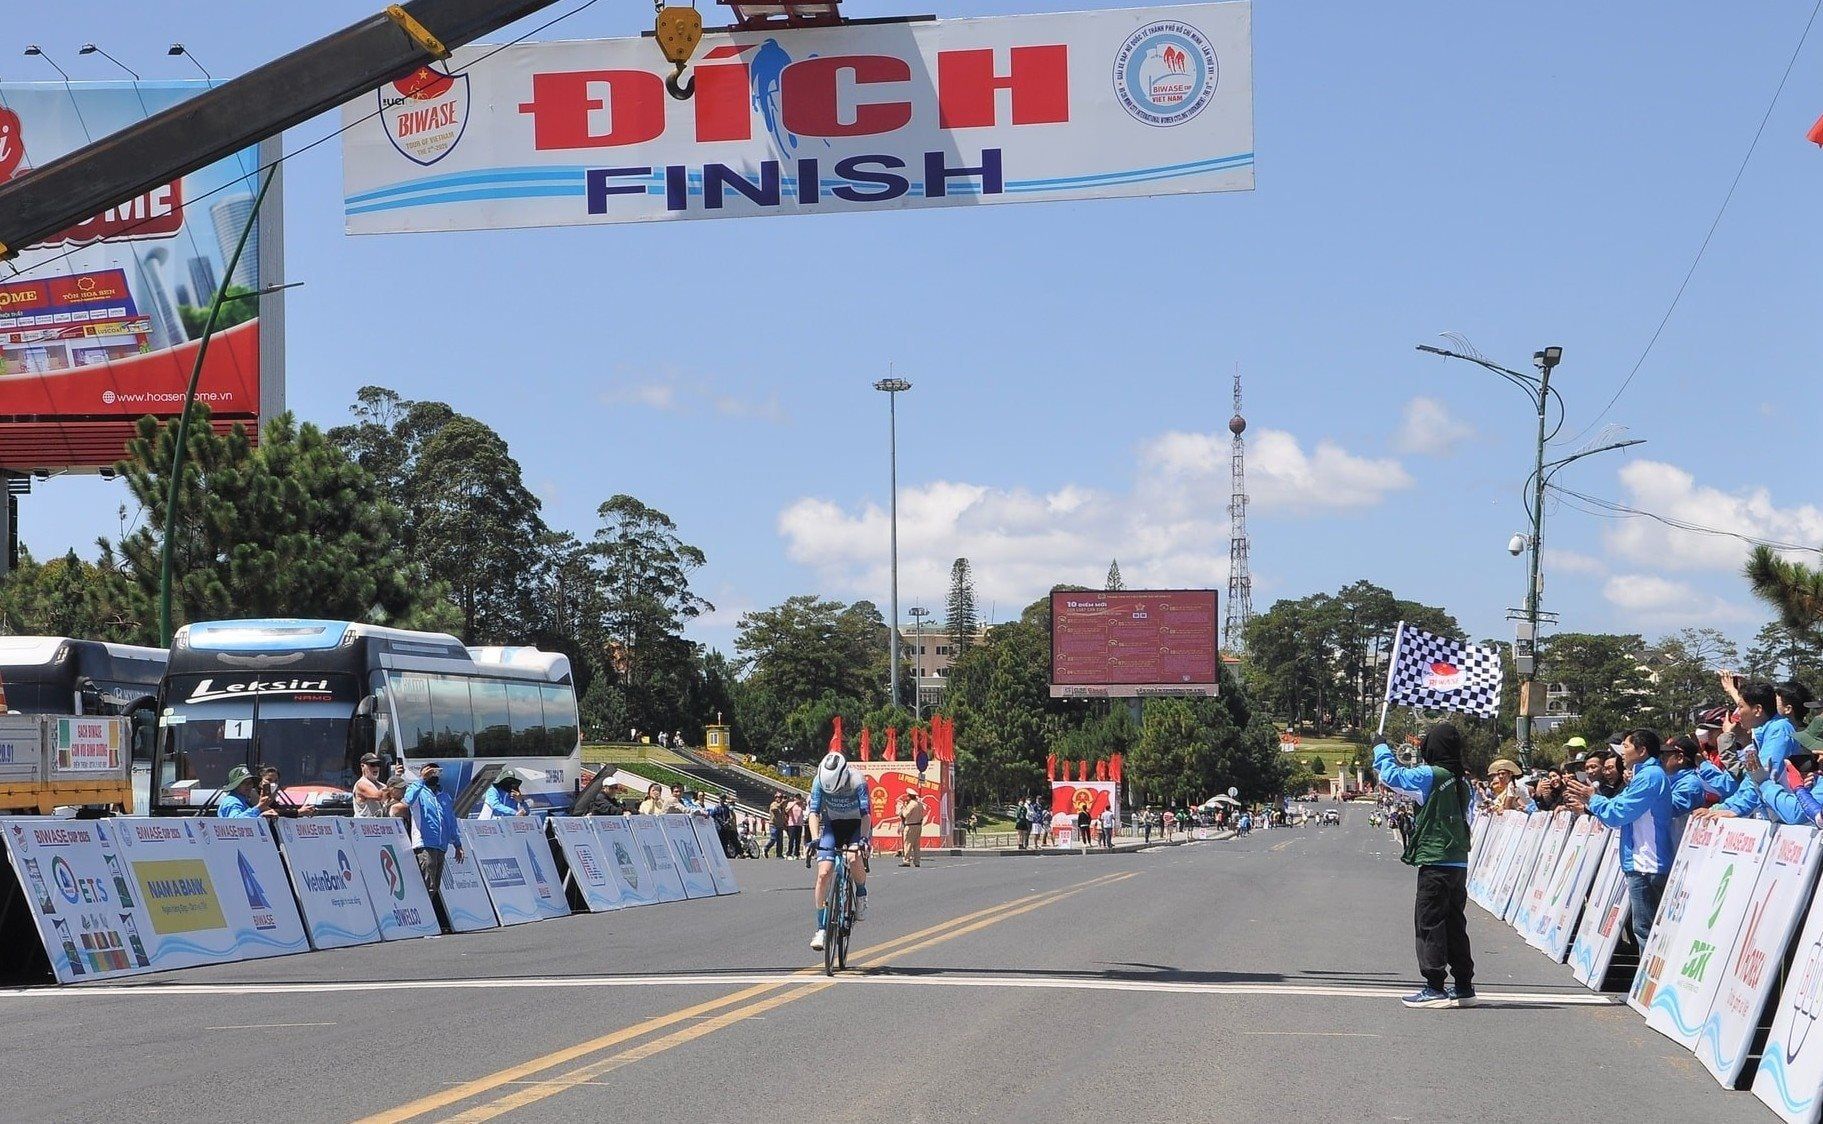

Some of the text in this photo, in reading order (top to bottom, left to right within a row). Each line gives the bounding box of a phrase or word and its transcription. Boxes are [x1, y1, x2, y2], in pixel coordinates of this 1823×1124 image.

[518, 43, 1069, 150] ĐÍCH
[1153, 84, 1183, 94] BIWASE
[397, 100, 459, 138] BIWASE
[586, 148, 1003, 215] FINISH
[116, 391, 233, 402] www.hoasenome.vn
[186, 678, 333, 704] Leksiri
[234, 721, 243, 738] 1
[34, 829, 70, 844] BIWASE
[147, 879, 173, 899] NAM
[181, 877, 209, 897] BANK
[253, 914, 275, 926] BIWASE
